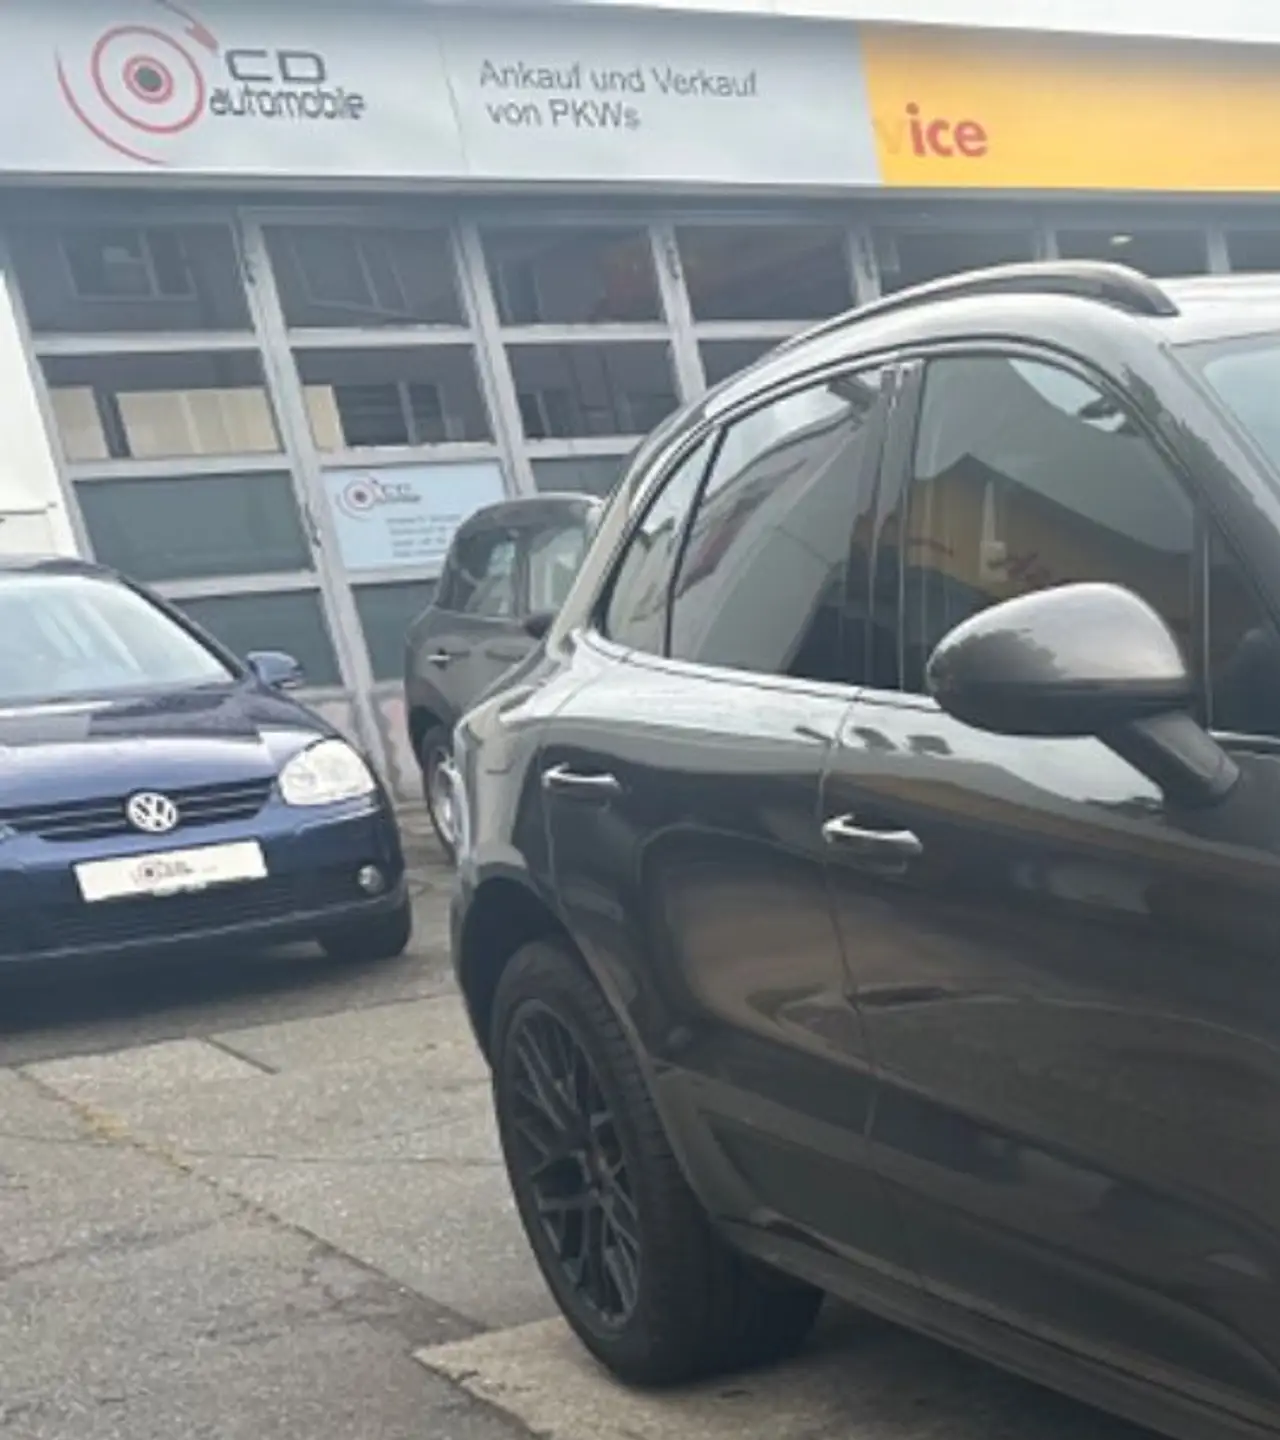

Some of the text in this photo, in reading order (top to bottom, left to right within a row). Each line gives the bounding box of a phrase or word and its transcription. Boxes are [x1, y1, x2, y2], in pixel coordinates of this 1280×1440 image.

[225, 49, 325, 82] CD
[480, 58, 757, 97] Ankauf und Verkauf
[210, 84, 366, 119] automobile
[487, 99, 640, 129] von PKWs
